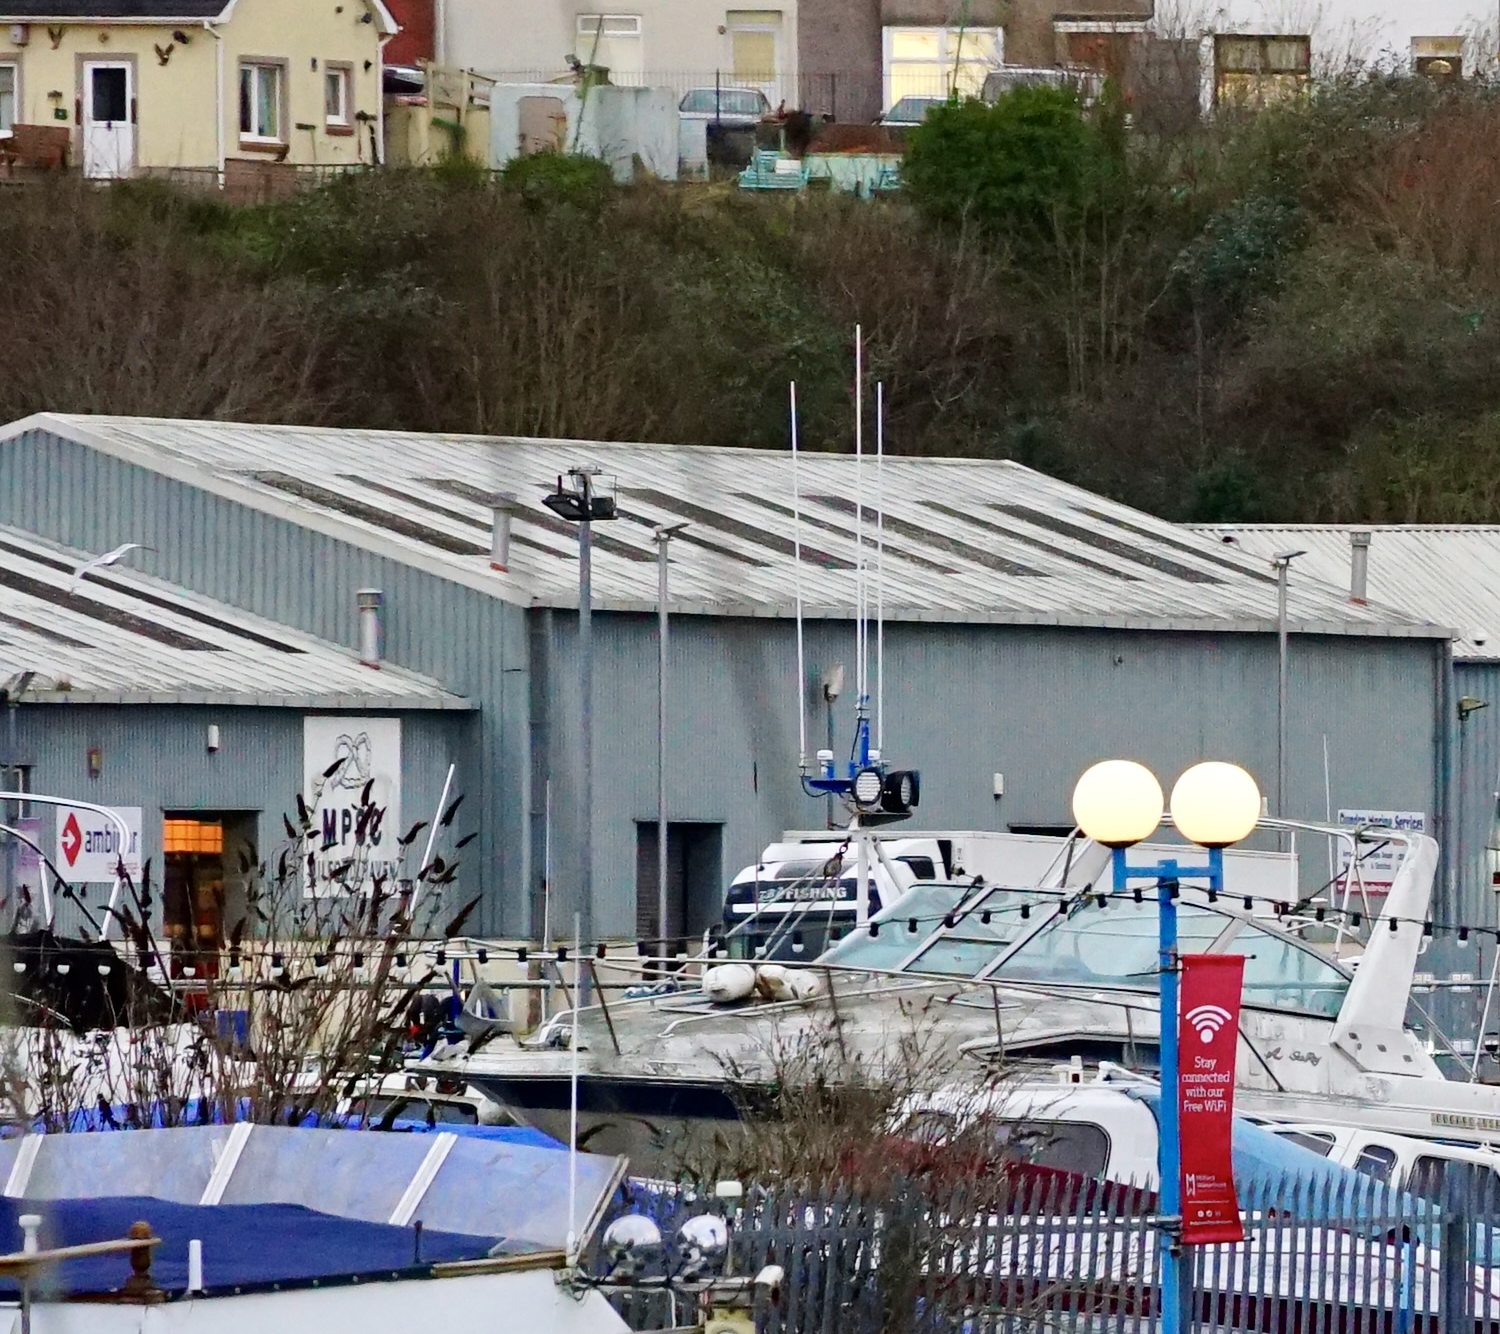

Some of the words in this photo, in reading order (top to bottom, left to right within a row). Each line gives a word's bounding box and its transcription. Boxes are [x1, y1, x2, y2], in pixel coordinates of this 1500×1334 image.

[1194, 1056, 1217, 1070] Stay
[1181, 1071, 1230, 1083] connected
[1185, 1086, 1206, 1097] with
[1207, 1088, 1224, 1097] our
[1183, 1100, 1203, 1112] Free
[1204, 1100, 1227, 1112] WiFi
